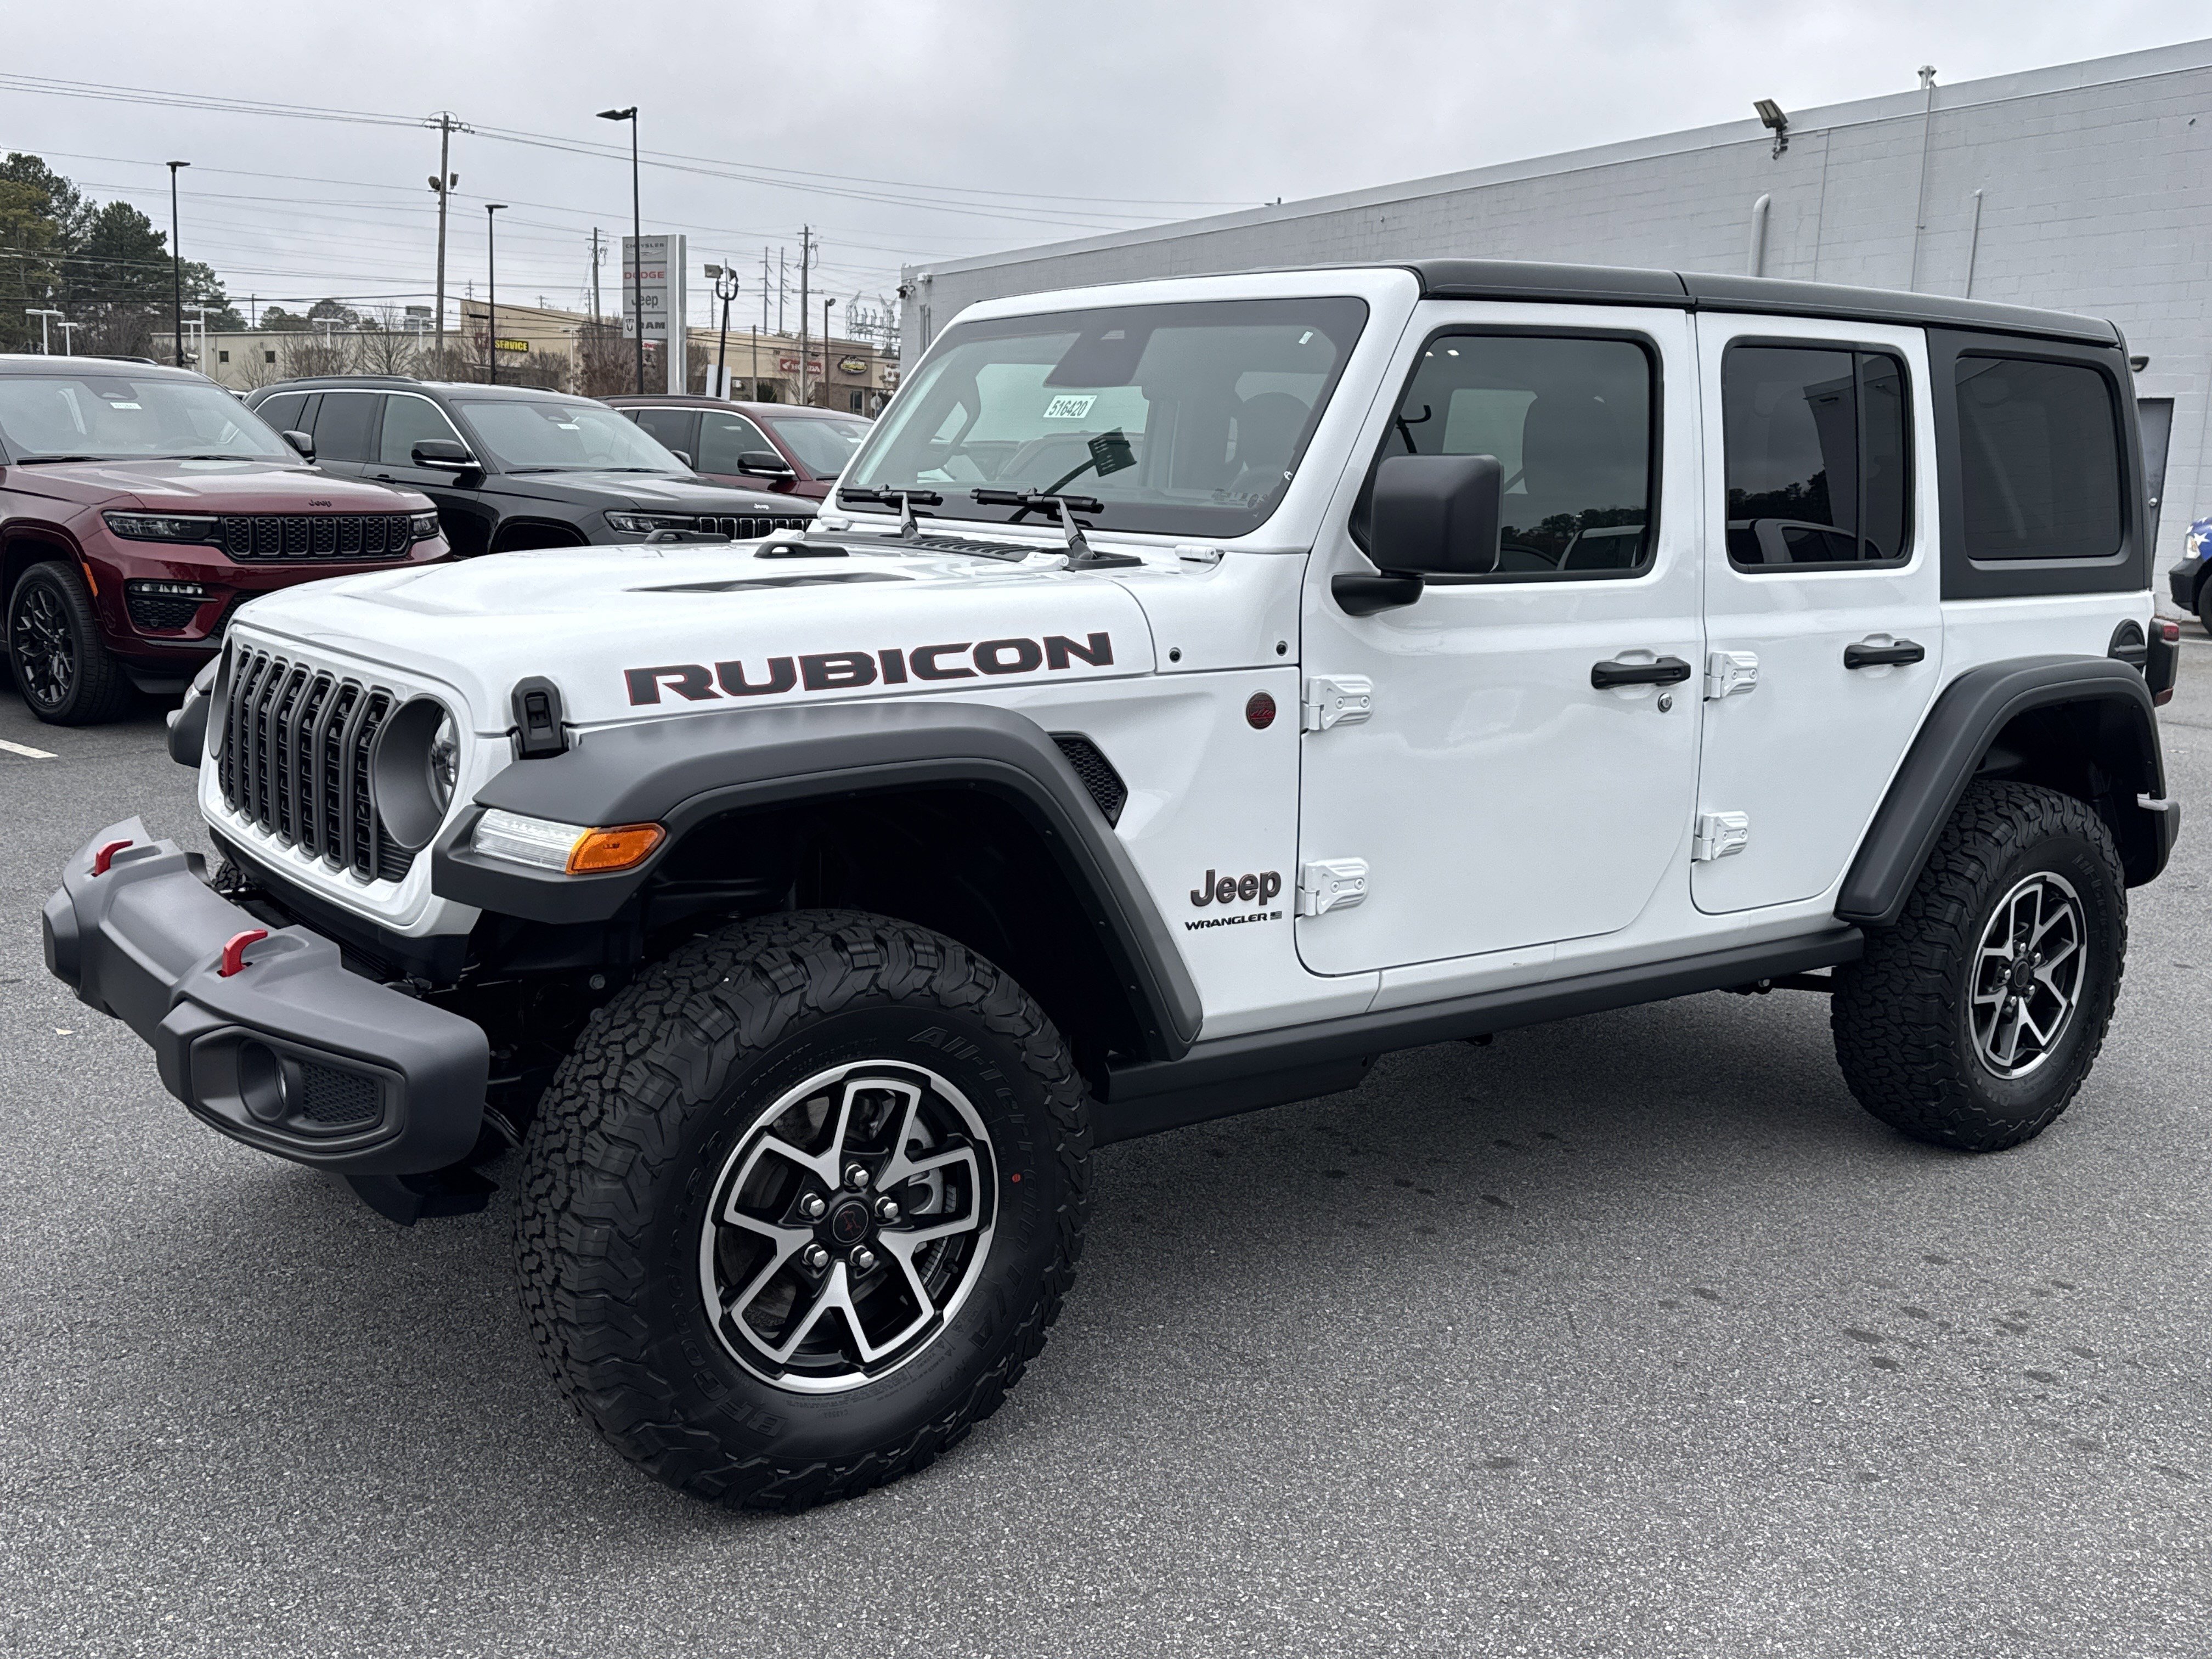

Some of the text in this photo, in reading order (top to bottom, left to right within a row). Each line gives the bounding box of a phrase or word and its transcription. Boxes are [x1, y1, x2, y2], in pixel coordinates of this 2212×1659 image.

[495, 340, 528, 351] SERVICE
[1048, 400, 1088, 416] 516420
[308, 499, 332, 508] Jeep
[623, 632, 1114, 706] RUBICON
[1190, 869, 1281, 906] Jeep
[1184, 913, 1267, 930] WRANGLER
